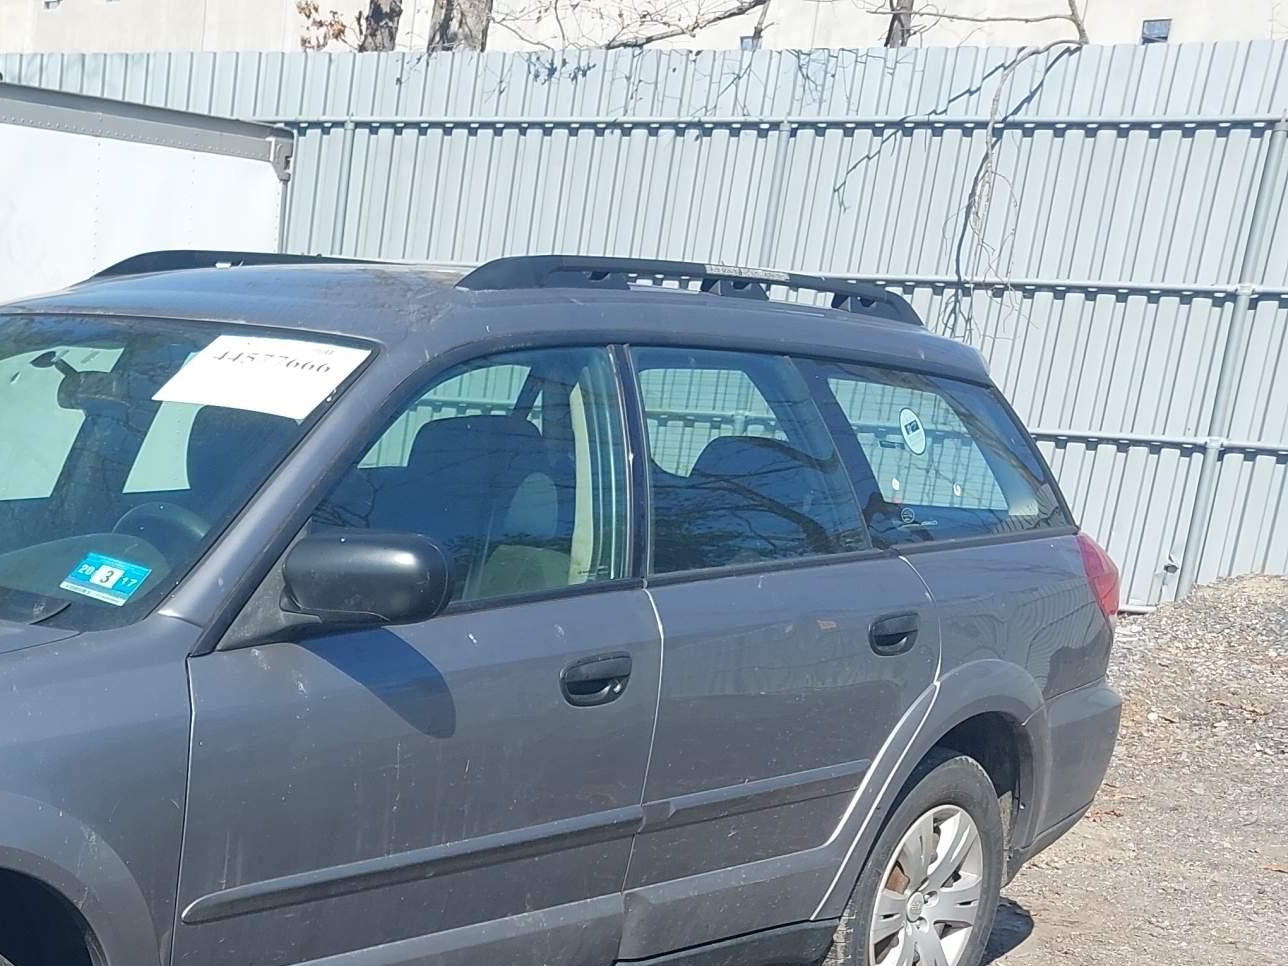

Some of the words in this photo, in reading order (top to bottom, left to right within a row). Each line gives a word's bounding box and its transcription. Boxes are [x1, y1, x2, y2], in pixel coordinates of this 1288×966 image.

[78, 563, 96, 576] 20
[99, 569, 114, 584] 3
[121, 576, 138, 587] 17
